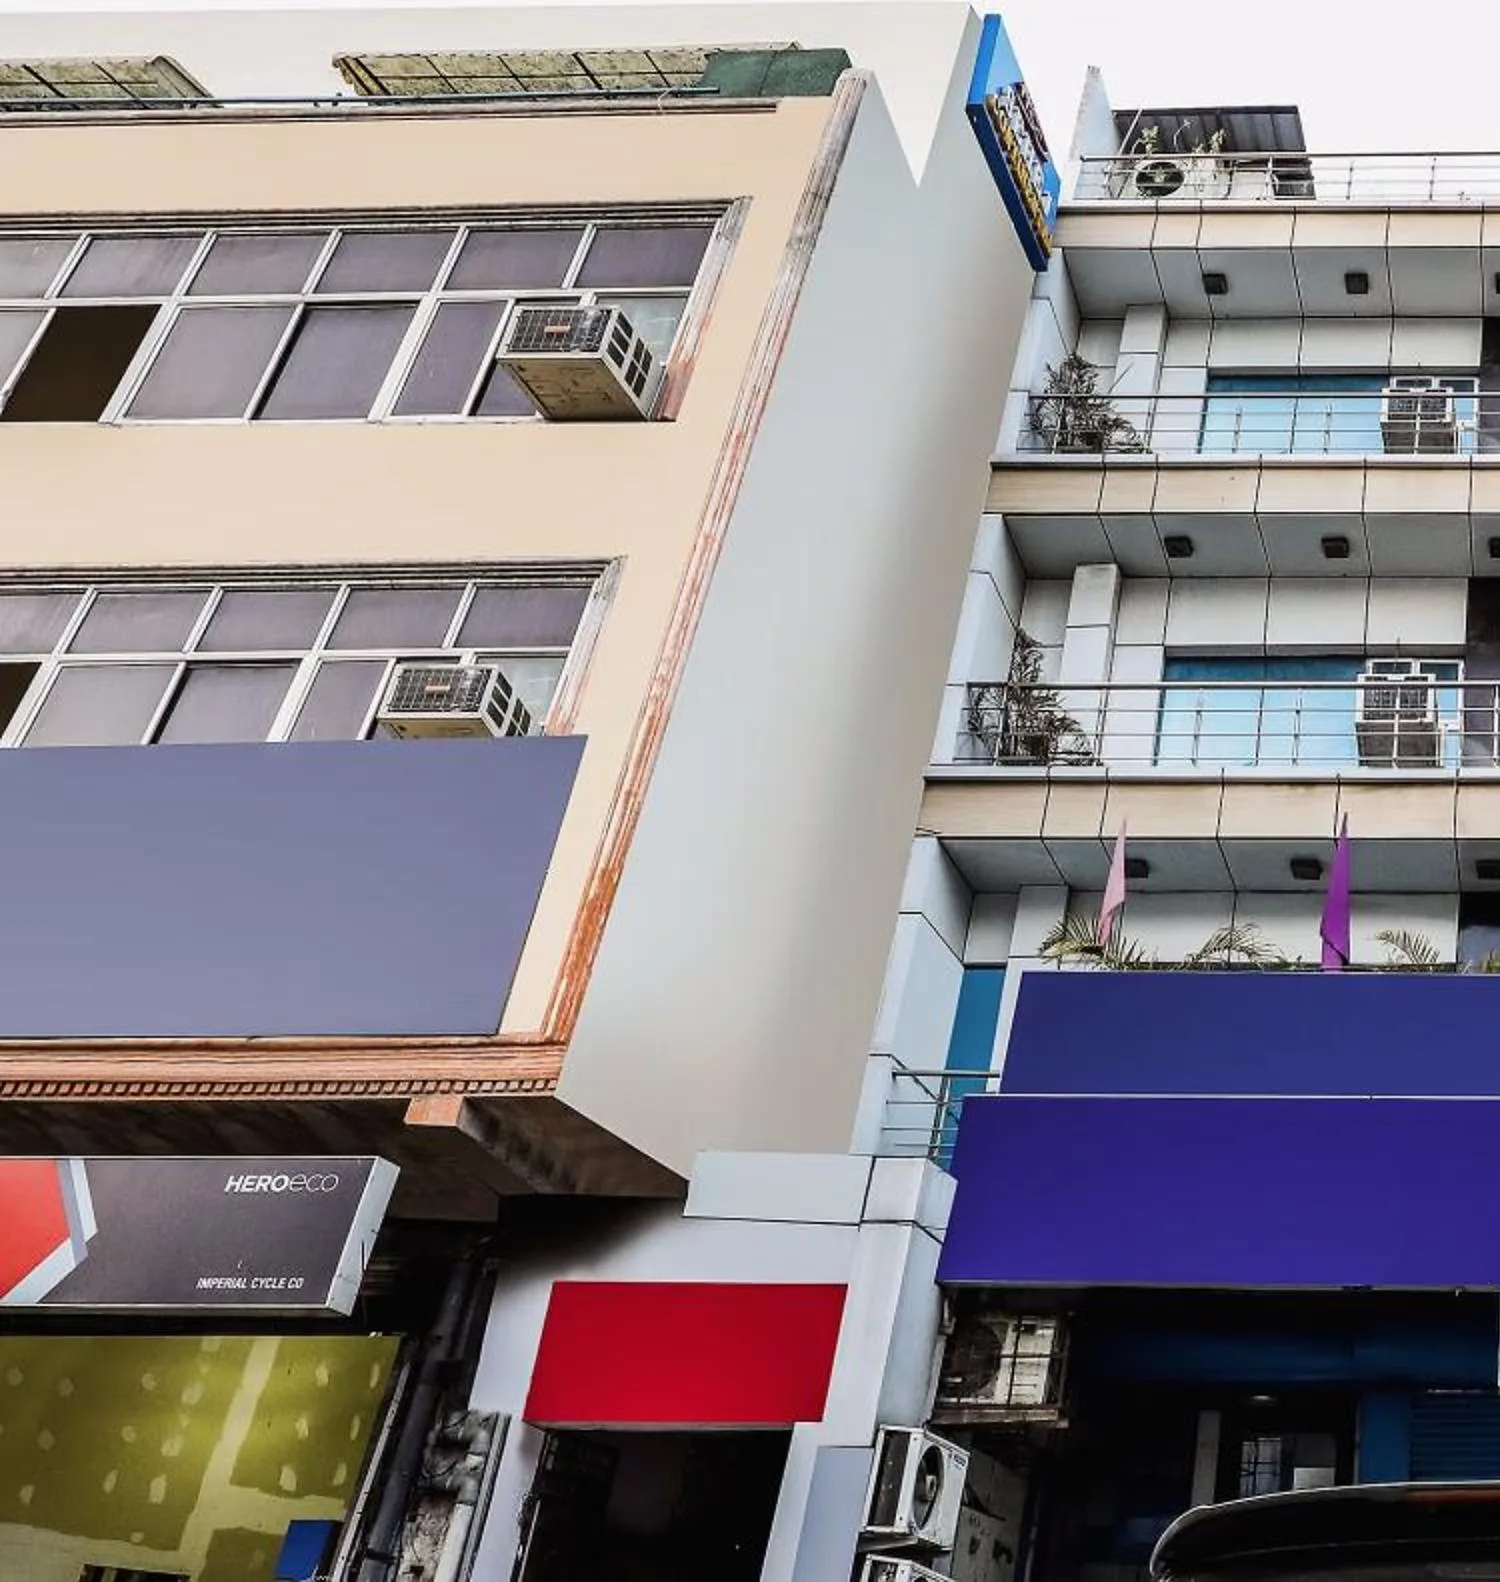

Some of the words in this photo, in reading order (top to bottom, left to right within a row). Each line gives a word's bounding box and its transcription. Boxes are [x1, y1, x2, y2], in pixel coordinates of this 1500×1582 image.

[196, 1277, 247, 1289] IMPERIAL
[251, 1277, 287, 1289] CYCLE
[288, 1277, 304, 1289] CO
